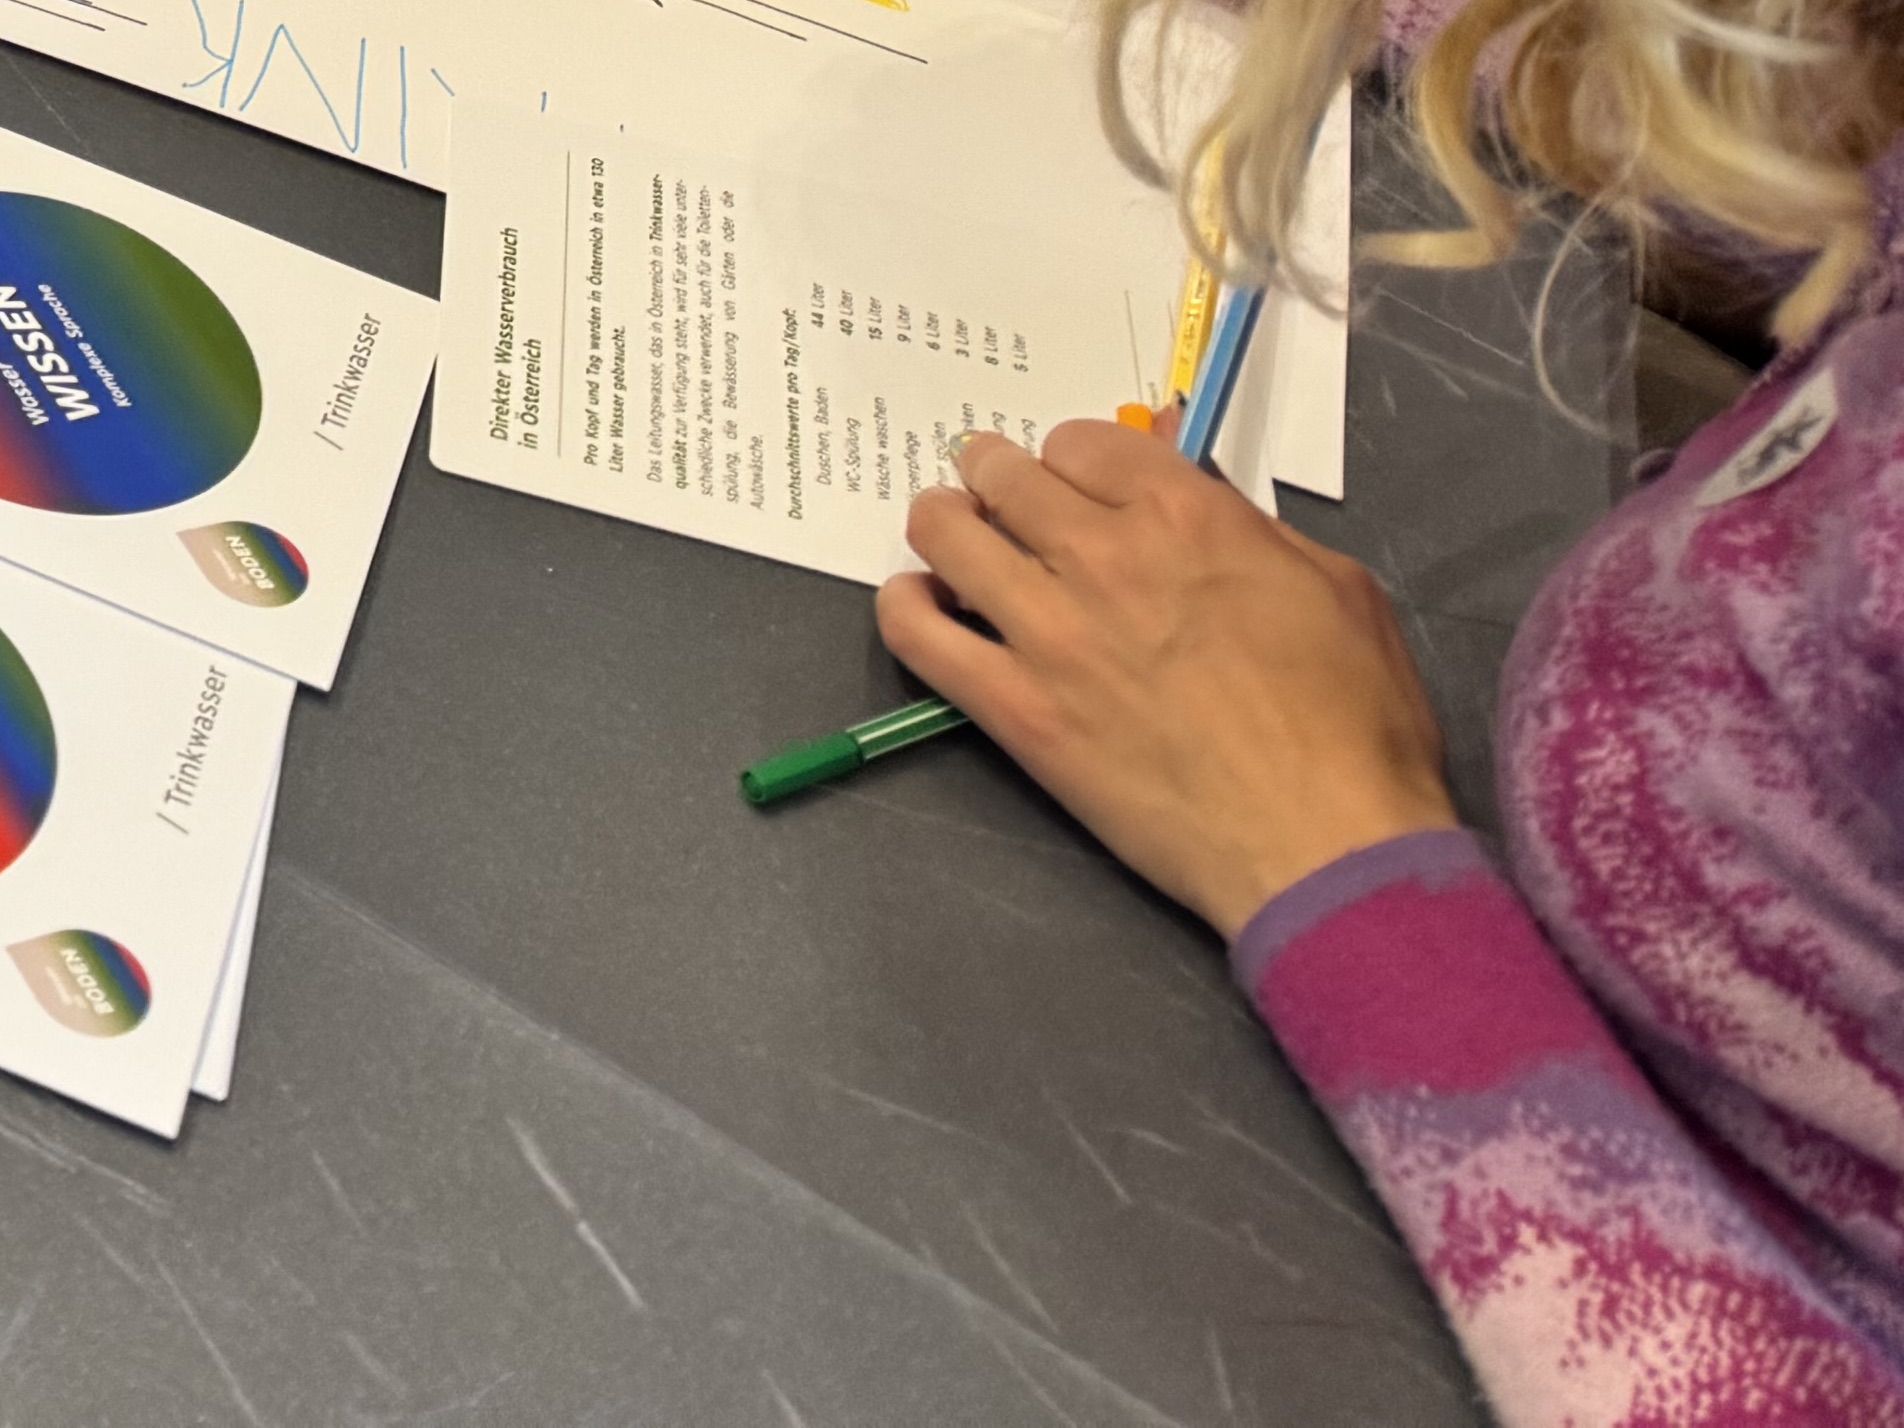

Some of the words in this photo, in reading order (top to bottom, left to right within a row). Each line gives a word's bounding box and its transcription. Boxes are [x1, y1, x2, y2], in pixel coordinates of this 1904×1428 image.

[591, 158, 603, 176] 130
[592, 182, 603, 208] etwa
[649, 174, 663, 241] Trinkwasser-
[590, 212, 603, 223] in
[586, 227, 603, 285] Österreich
[652, 246, 662, 256] in
[495, 228, 517, 363] Wasserverbrauch
[588, 290, 601, 302] in
[646, 260, 663, 317] Österreich
[812, 283, 825, 308] Liter
[38, 284, 83, 338] Sprache
[840, 290, 853, 316] Liter
[868, 297, 882, 323] Liter
[588, 306, 601, 349] werden
[651, 322, 662, 333] in
[811, 312, 824, 328] 44
[840, 319, 853, 336] 40
[898, 304, 911, 330] Liter
[926, 312, 940, 338] Liter
[868, 327, 882, 339] 15
[897, 334, 911, 342] 9
[955, 319, 969, 345] Liter
[985, 326, 998, 352] Liter
[611, 326, 627, 391] gebraucht.
[649, 337, 663, 358] das
[78, 342, 132, 407] Komplexe
[321, 313, 381, 428] Trinkwasser
[586, 355, 603, 375] Tag
[516, 339, 541, 425] Österreich
[586, 380, 600, 405] und
[787, 372, 800, 394] pro
[489, 370, 511, 441] Direkter
[610, 394, 624, 438] Wasser
[814, 387, 829, 425] Baden
[585, 409, 600, 439] Kopf
[518, 433, 537, 449] in
[584, 444, 598, 465] Pro
[609, 443, 623, 472] Liter
[672, 440, 689, 489] qualität
[786, 397, 802, 520] Durchschnittswerte
[646, 460, 662, 482] Das
[225, 534, 274, 590] BODEN
[163, 665, 229, 812] Trinkwasser
[60, 948, 113, 1015] BODEN
